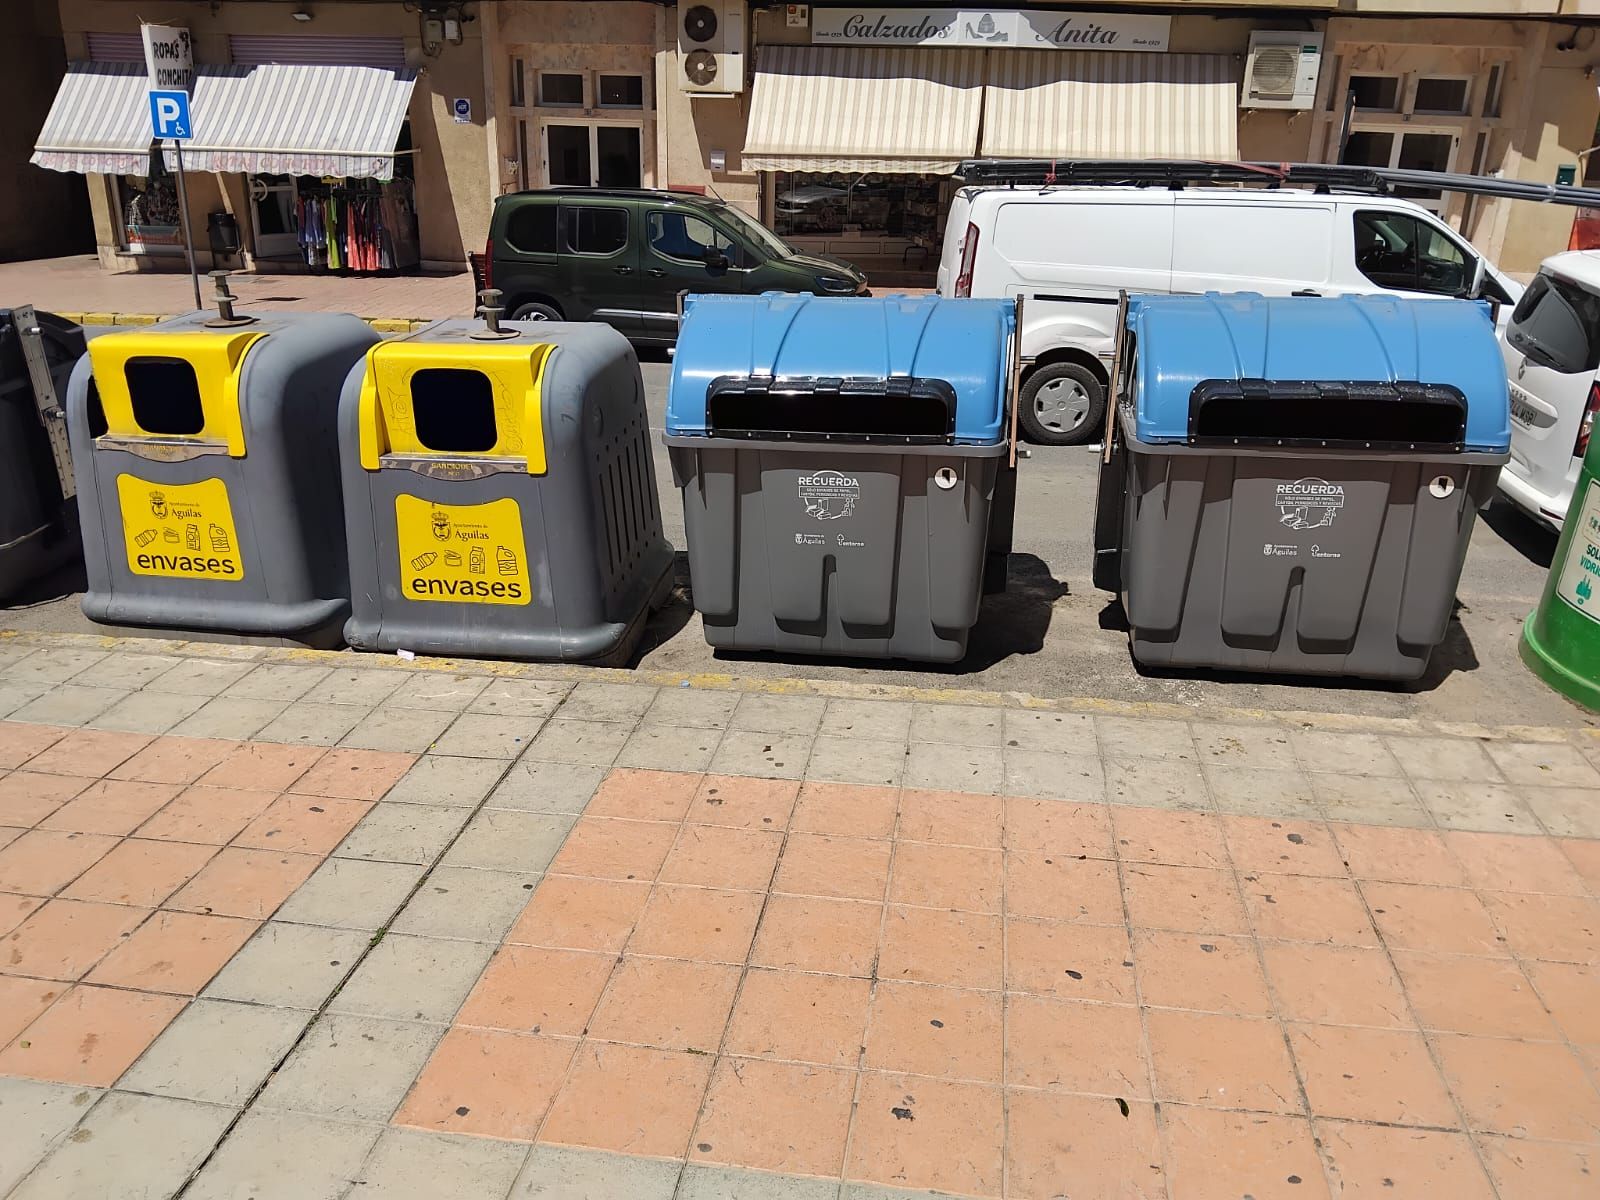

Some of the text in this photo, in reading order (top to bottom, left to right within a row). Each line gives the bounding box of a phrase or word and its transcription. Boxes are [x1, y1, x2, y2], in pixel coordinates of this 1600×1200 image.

[843, 15, 951, 38] Calzados
[1035, 18, 1119, 44] Anita
[153, 42, 180, 59] ROPAS
[157, 98, 180, 133] P
[798, 477, 859, 487] RECUERDA
[1276, 485, 1344, 494] RECUERDA
[1586, 544, 1600, 561] SOL
[137, 554, 235, 574] envases
[412, 578, 522, 598] envases
